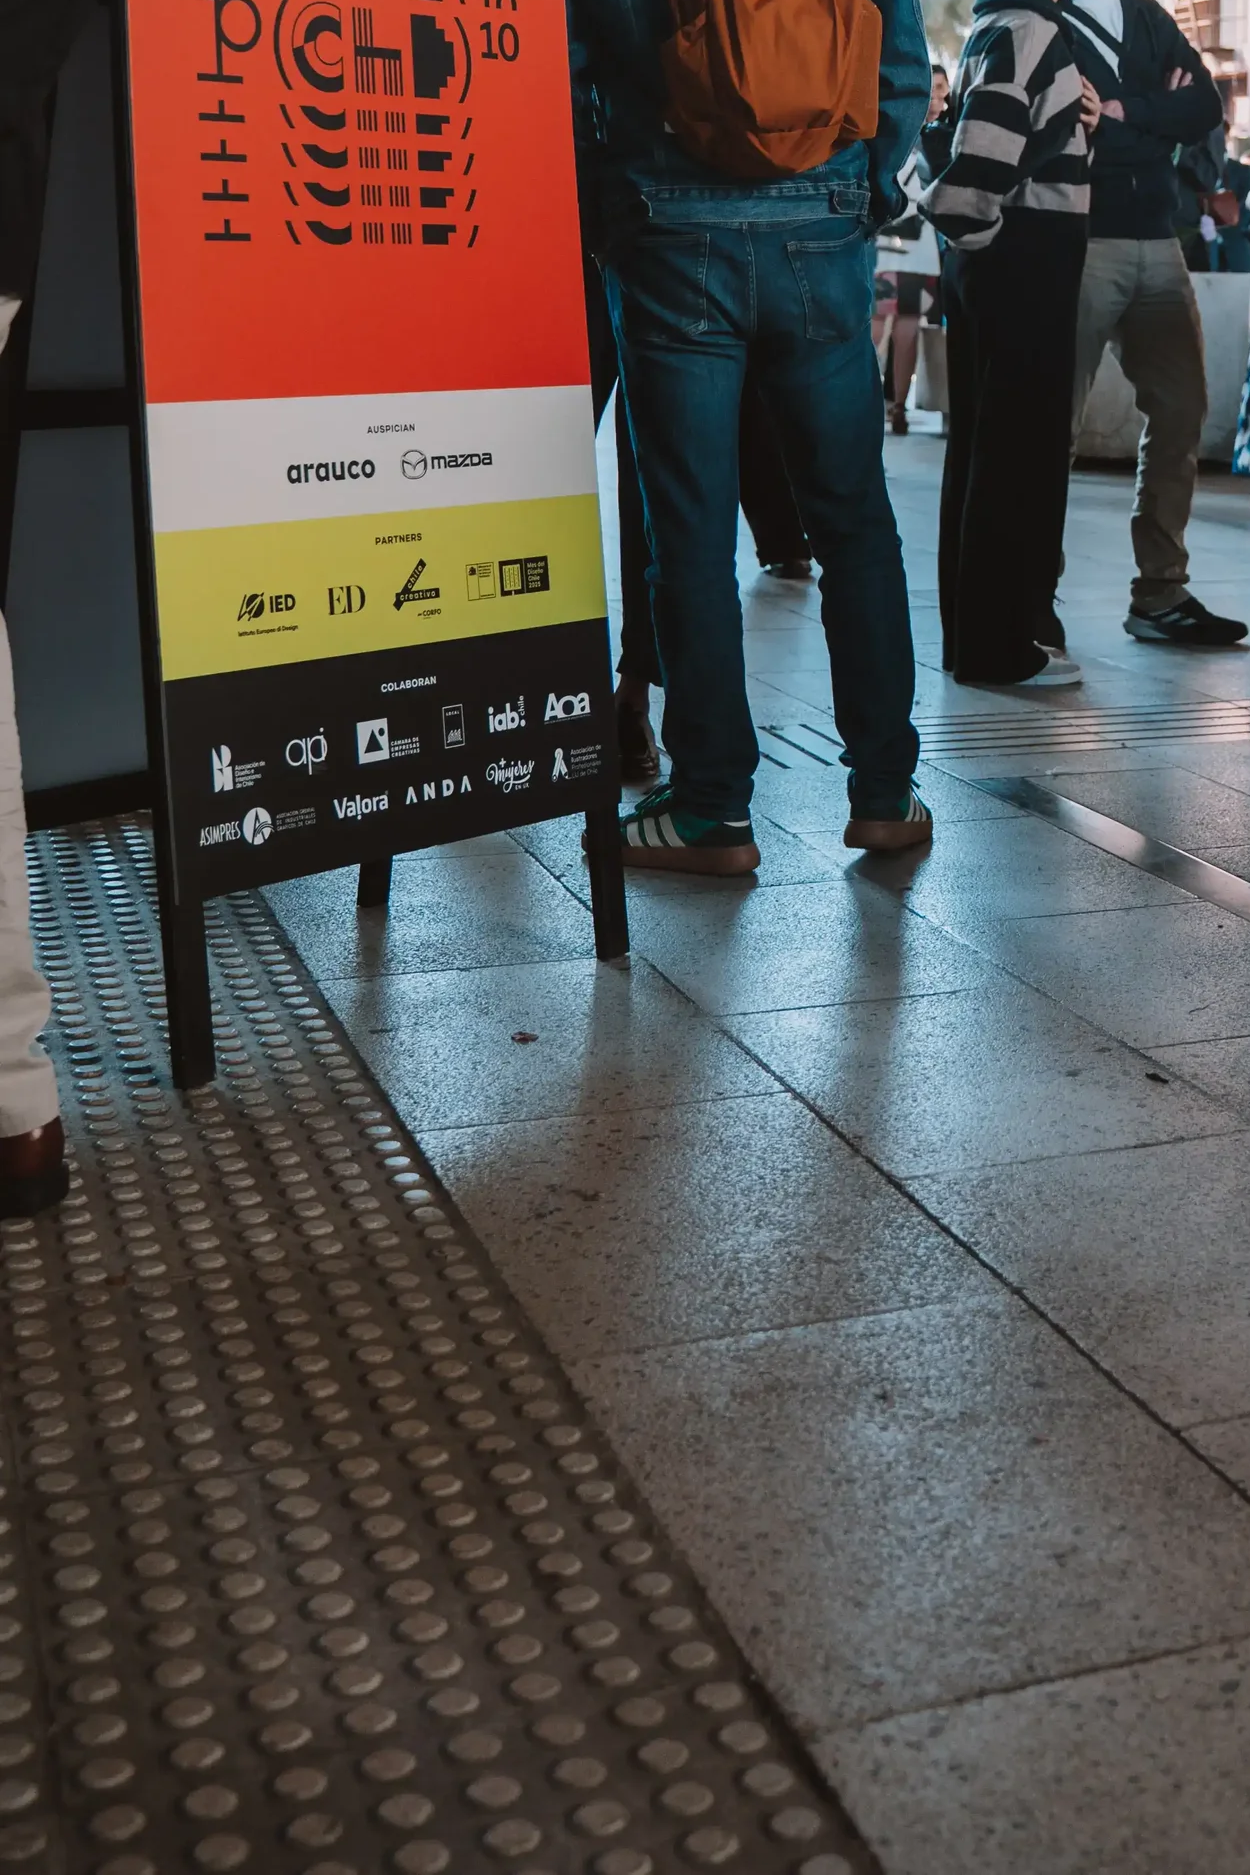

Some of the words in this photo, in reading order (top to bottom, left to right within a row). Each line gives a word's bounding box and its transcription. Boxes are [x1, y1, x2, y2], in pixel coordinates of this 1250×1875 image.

[367, 423, 416, 434] AUSPICIAN
[287, 459, 376, 484] arauco
[375, 533, 422, 545] PARTNERS
[269, 593, 296, 613] IED
[327, 584, 366, 616] ED
[400, 590, 436, 601] creativo
[381, 676, 437, 692] COLABORAN
[285, 727, 328, 775] api
[391, 742, 420, 752] EMPRESAS
[391, 749, 420, 758] CREATIVAS
[405, 775, 472, 805] ANDA
[333, 794, 389, 820] Valora
[199, 821, 241, 847] ASIMPRES
